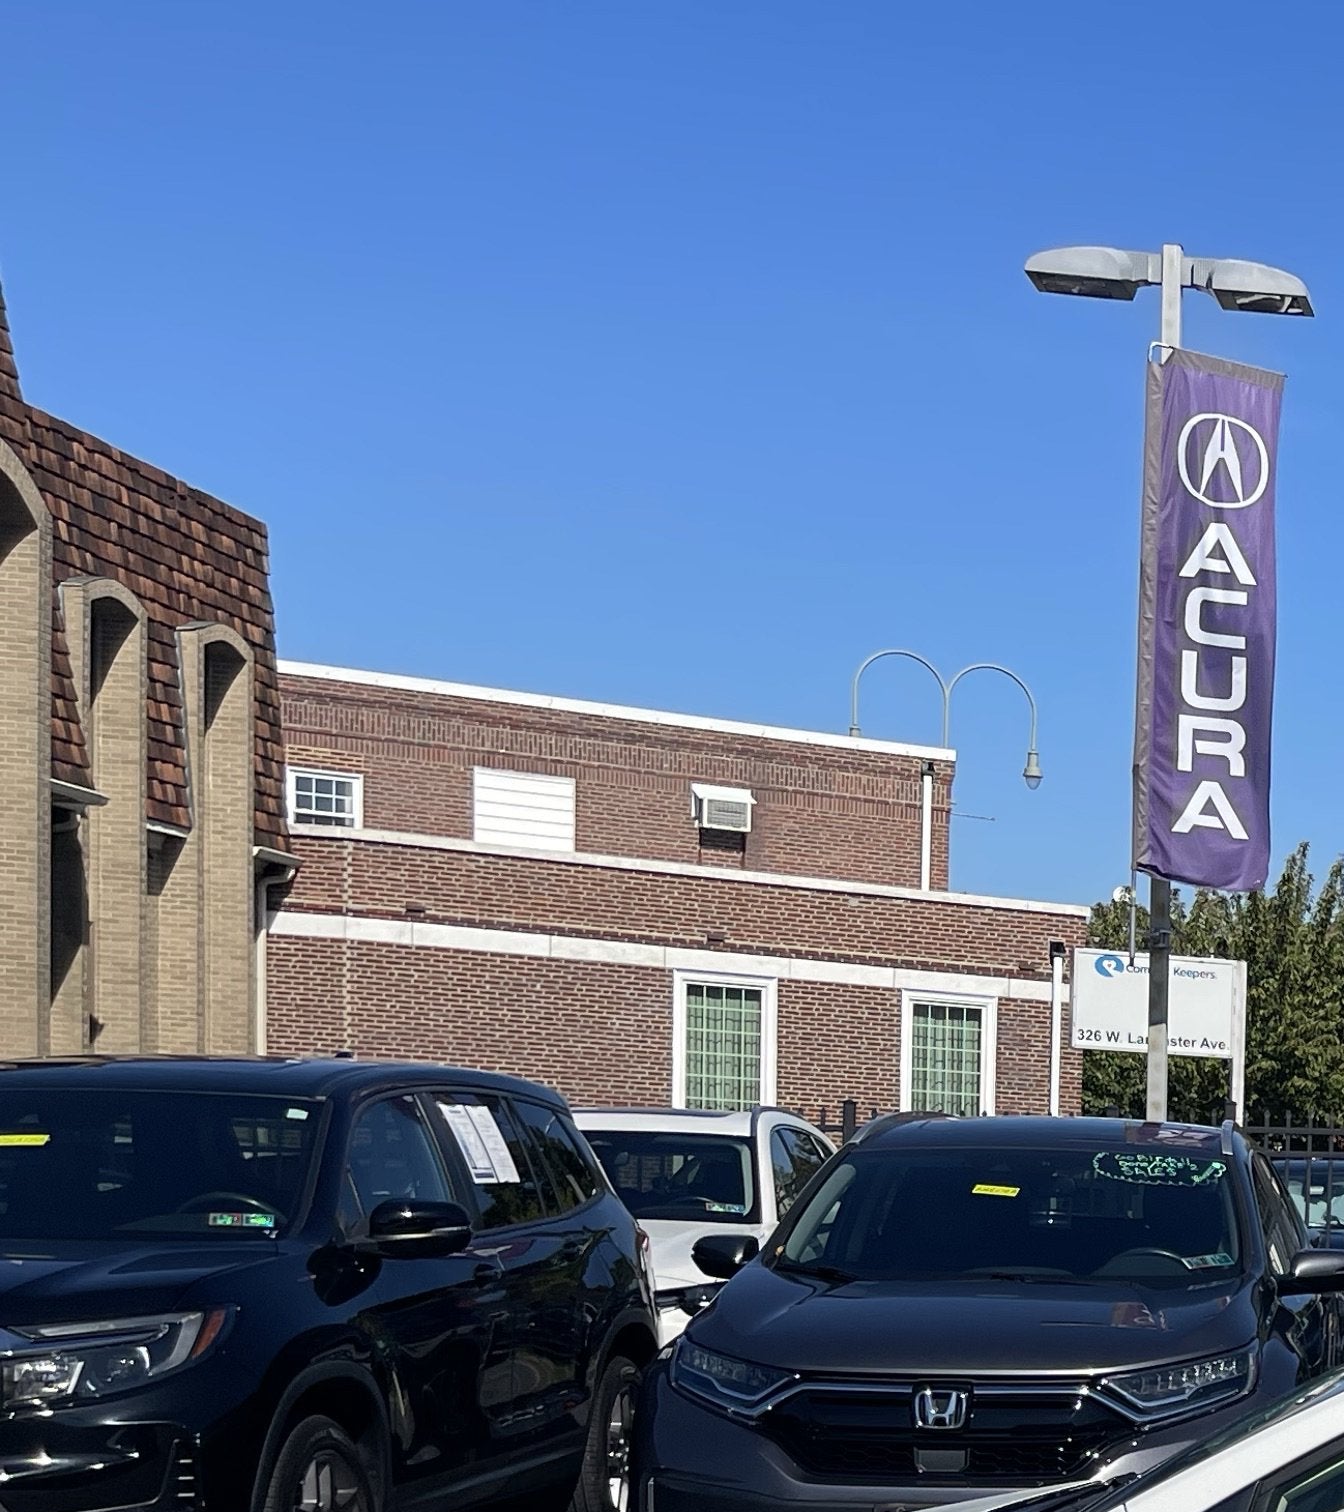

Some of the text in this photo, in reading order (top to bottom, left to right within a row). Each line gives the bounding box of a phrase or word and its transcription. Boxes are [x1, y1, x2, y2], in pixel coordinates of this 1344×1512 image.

[1171, 522, 1257, 840] ACURA
[1077, 1028, 1102, 1042] 326
[1128, 1032, 1197, 1049] Laster
